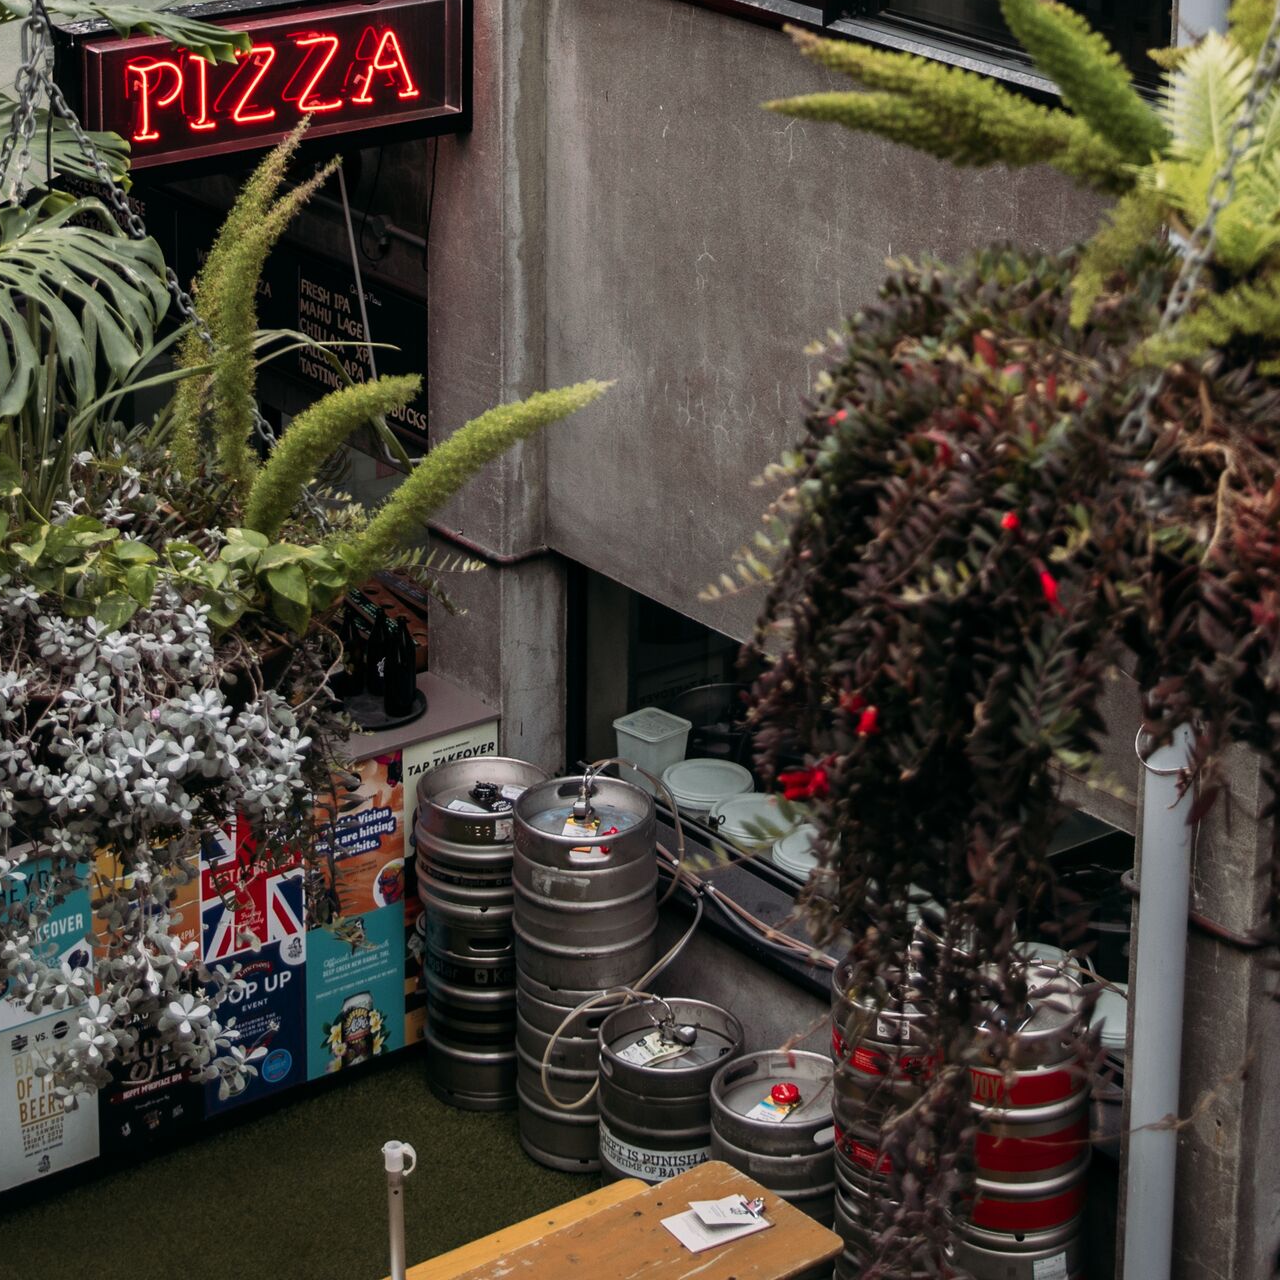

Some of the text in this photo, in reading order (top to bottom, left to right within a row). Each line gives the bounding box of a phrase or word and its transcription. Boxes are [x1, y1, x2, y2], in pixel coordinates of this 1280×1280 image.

[125, 29, 420, 142] PIZZA
[301, 279, 330, 306] FRESH
[334, 292, 351, 314] IPA
[300, 299, 331, 324] MAHU
[300, 357, 344, 390] TASTING
[345, 360, 365, 384] APA
[408, 762, 429, 776] TAP
[433, 742, 495, 767] TAKEOVER
[358, 808, 390, 824] Vision
[341, 831, 358, 844] are
[360, 819, 394, 837] hitting
[209, 868, 236, 889] BEST
[264, 970, 292, 992] UP
[242, 997, 268, 1012] EVENT
[17, 1076, 33, 1101] OF
[19, 1090, 65, 1122] BEERS
[627, 1149, 639, 1161] IS
[642, 1151, 709, 1167] PUNISHA
[644, 1165, 657, 1175] OF
